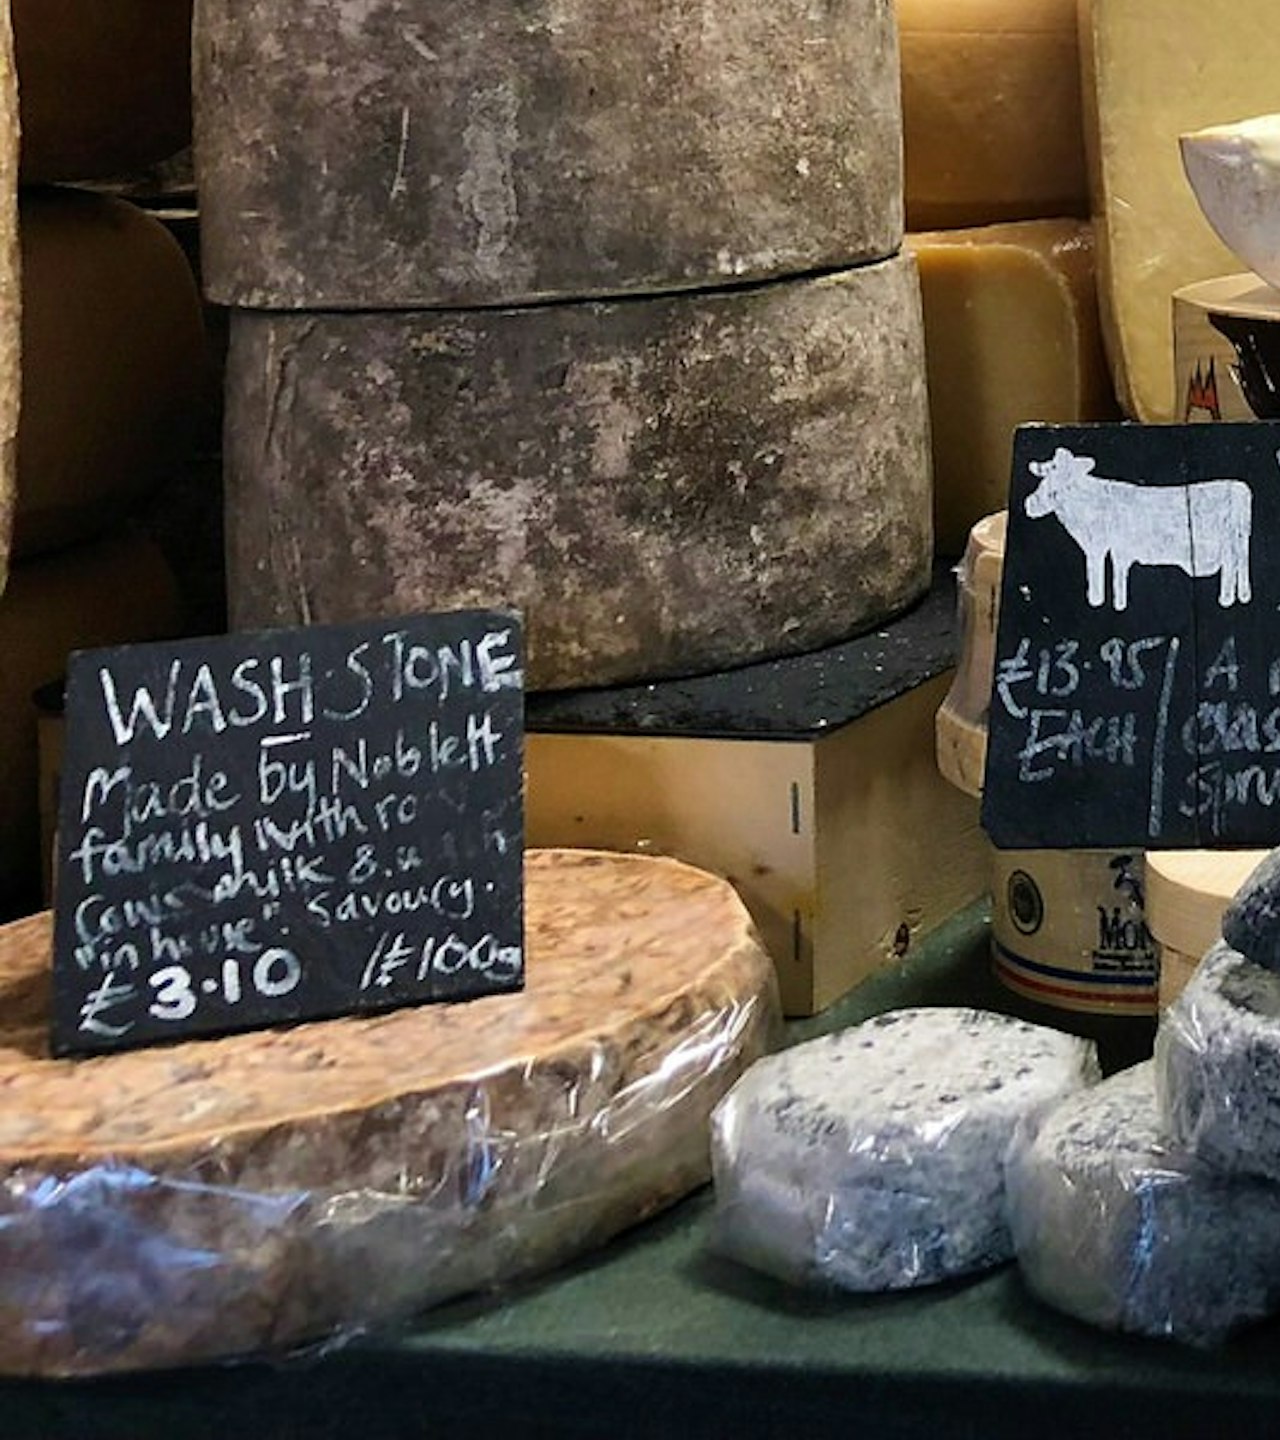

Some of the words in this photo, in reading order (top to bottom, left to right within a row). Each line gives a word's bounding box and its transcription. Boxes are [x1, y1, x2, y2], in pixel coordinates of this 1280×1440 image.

[1204, 634, 1242, 693] A
[82, 754, 241, 836] Made
[259, 746, 318, 813] by
[71, 820, 244, 885] family
[79, 948, 301, 1037] £3.10
